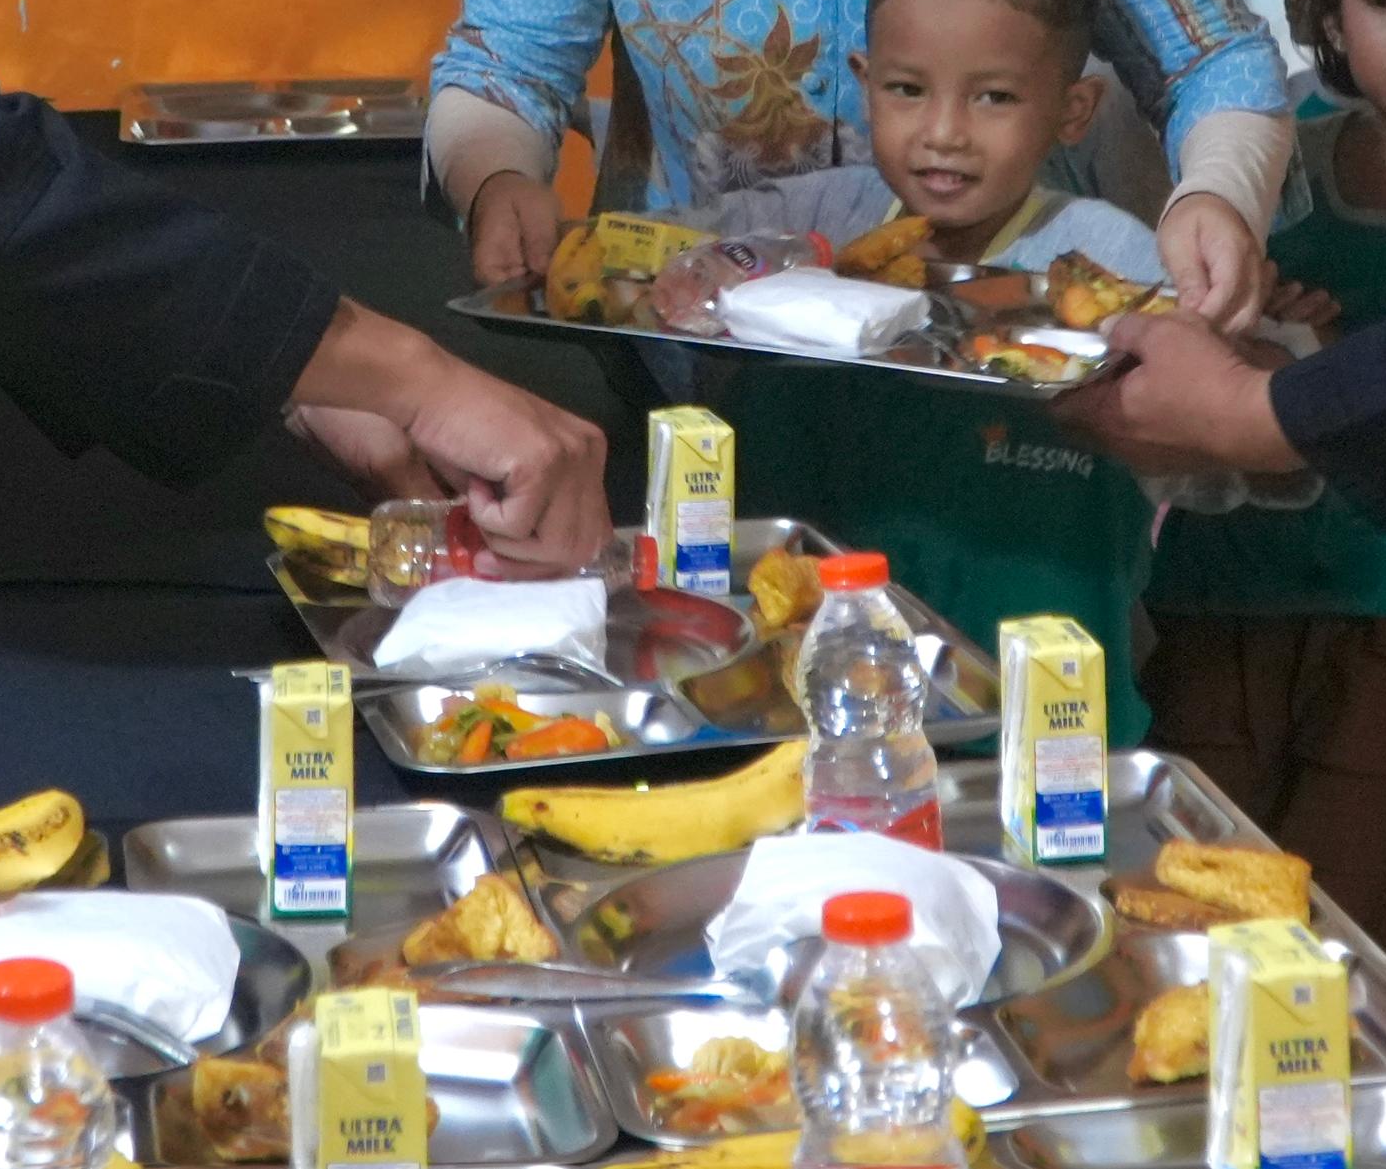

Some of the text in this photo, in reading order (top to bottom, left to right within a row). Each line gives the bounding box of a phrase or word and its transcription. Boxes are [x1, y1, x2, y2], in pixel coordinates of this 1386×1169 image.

[984, 440, 1094, 480] BLESSING
[684, 471, 721, 484] ULTRA
[688, 483, 718, 495] MILK
[1043, 700, 1089, 717] ULTRA
[1048, 716, 1085, 731] MILK
[285, 751, 334, 766] ULTRA
[290, 767, 329, 780] MILK
[1269, 1036, 1329, 1058] ULTRA
[1276, 1057, 1323, 1075] MILK
[340, 1116, 403, 1135] ULTRA
[346, 1138, 397, 1154] MILK
